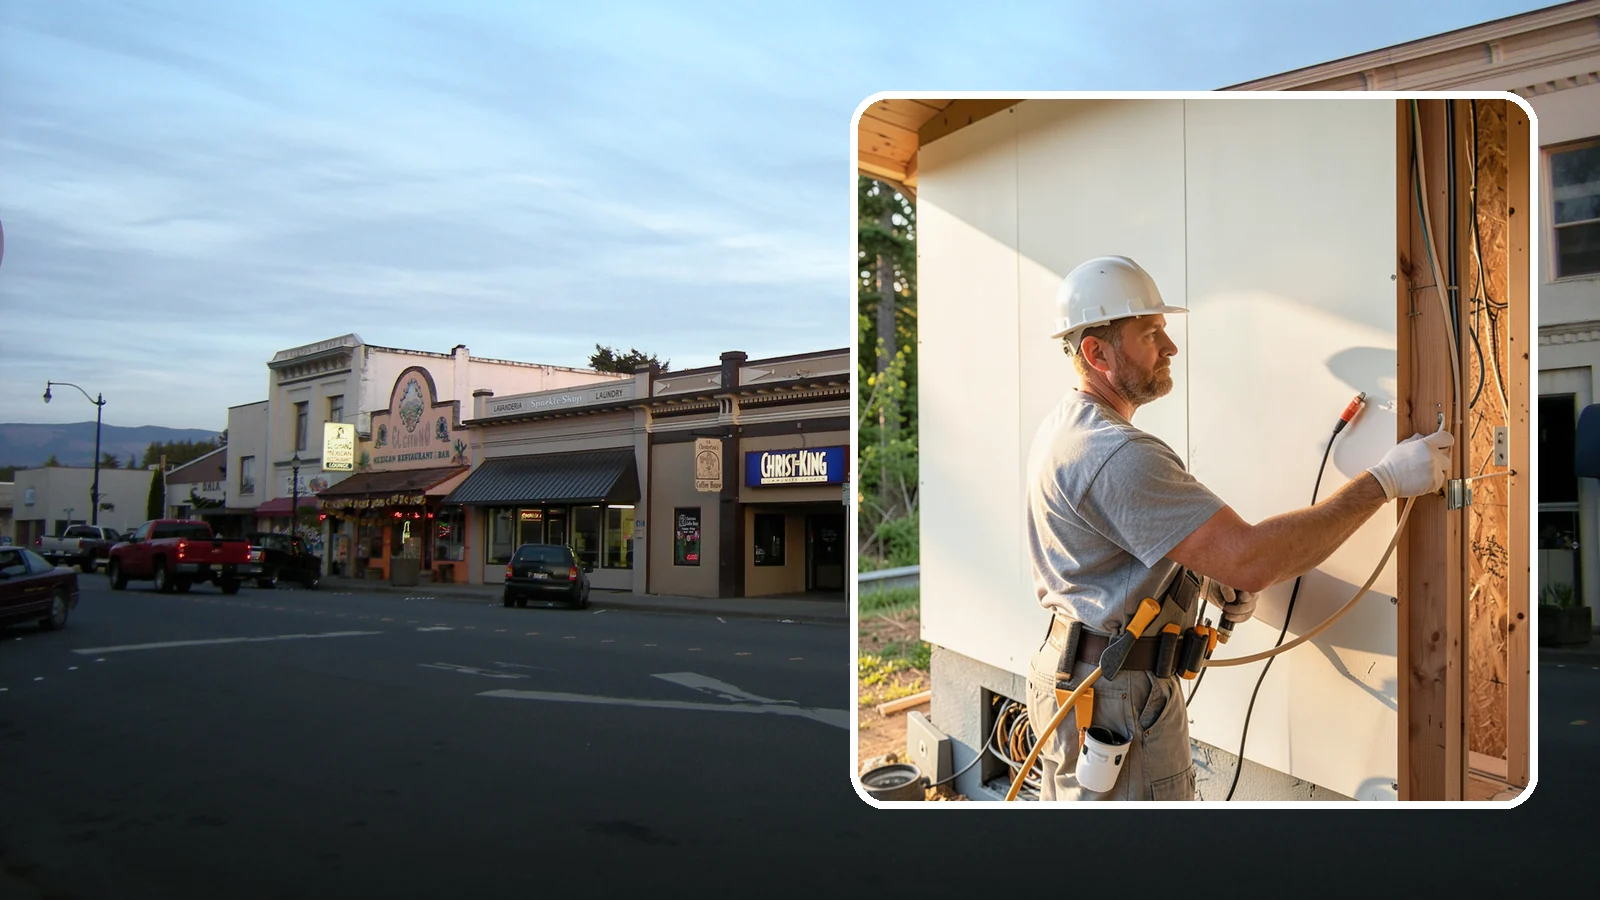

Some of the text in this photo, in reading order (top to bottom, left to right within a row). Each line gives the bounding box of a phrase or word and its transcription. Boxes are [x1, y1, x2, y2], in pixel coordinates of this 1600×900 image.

[531, 394, 582, 409] Sparkle Shop
[595, 389, 623, 400] LAUNDRY
[493, 402, 522, 413] LAVANDERIA
[373, 456, 396, 464] MEXICAN
[397, 451, 434, 462] RESTAURANT
[438, 450, 450, 459] BAR
[761, 450, 827, 478] CHRIST KING
